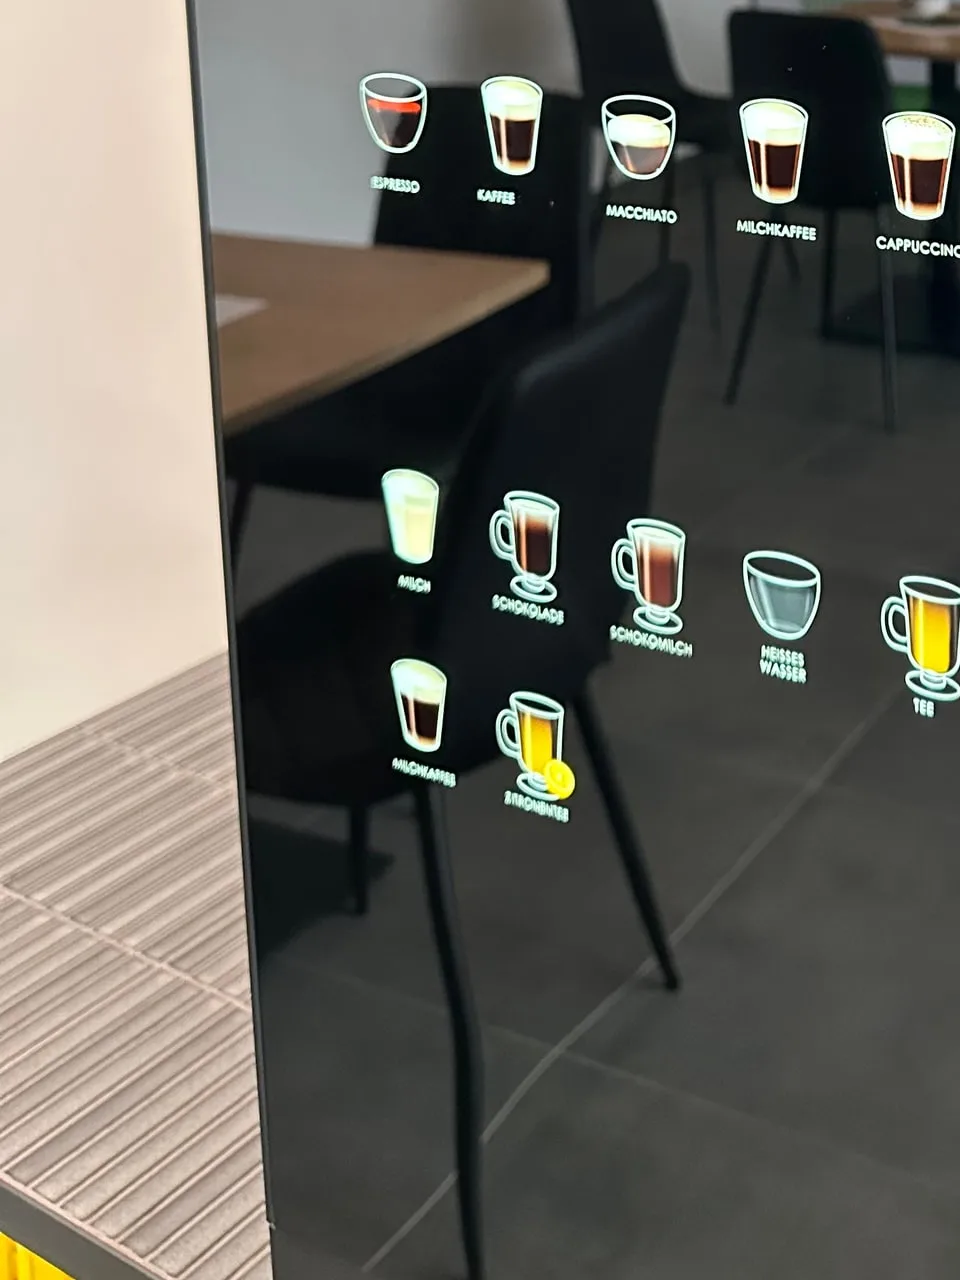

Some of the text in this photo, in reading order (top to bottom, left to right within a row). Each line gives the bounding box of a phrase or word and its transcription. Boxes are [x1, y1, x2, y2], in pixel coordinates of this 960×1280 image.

[370, 176, 421, 194] ESPRESSO
[477, 189, 516, 205] KAFFEE
[606, 205, 677, 224] MACCHIATO
[736, 220, 817, 241] MILCHKAFFEE
[398, 575, 432, 593] MILCH
[491, 594, 565, 626] SCHOKOLADE
[609, 625, 693, 658] SCHOKOMILCH
[760, 644, 805, 669] HEISSES
[759, 658, 807, 684] WASSER
[912, 698, 935, 718] TEE
